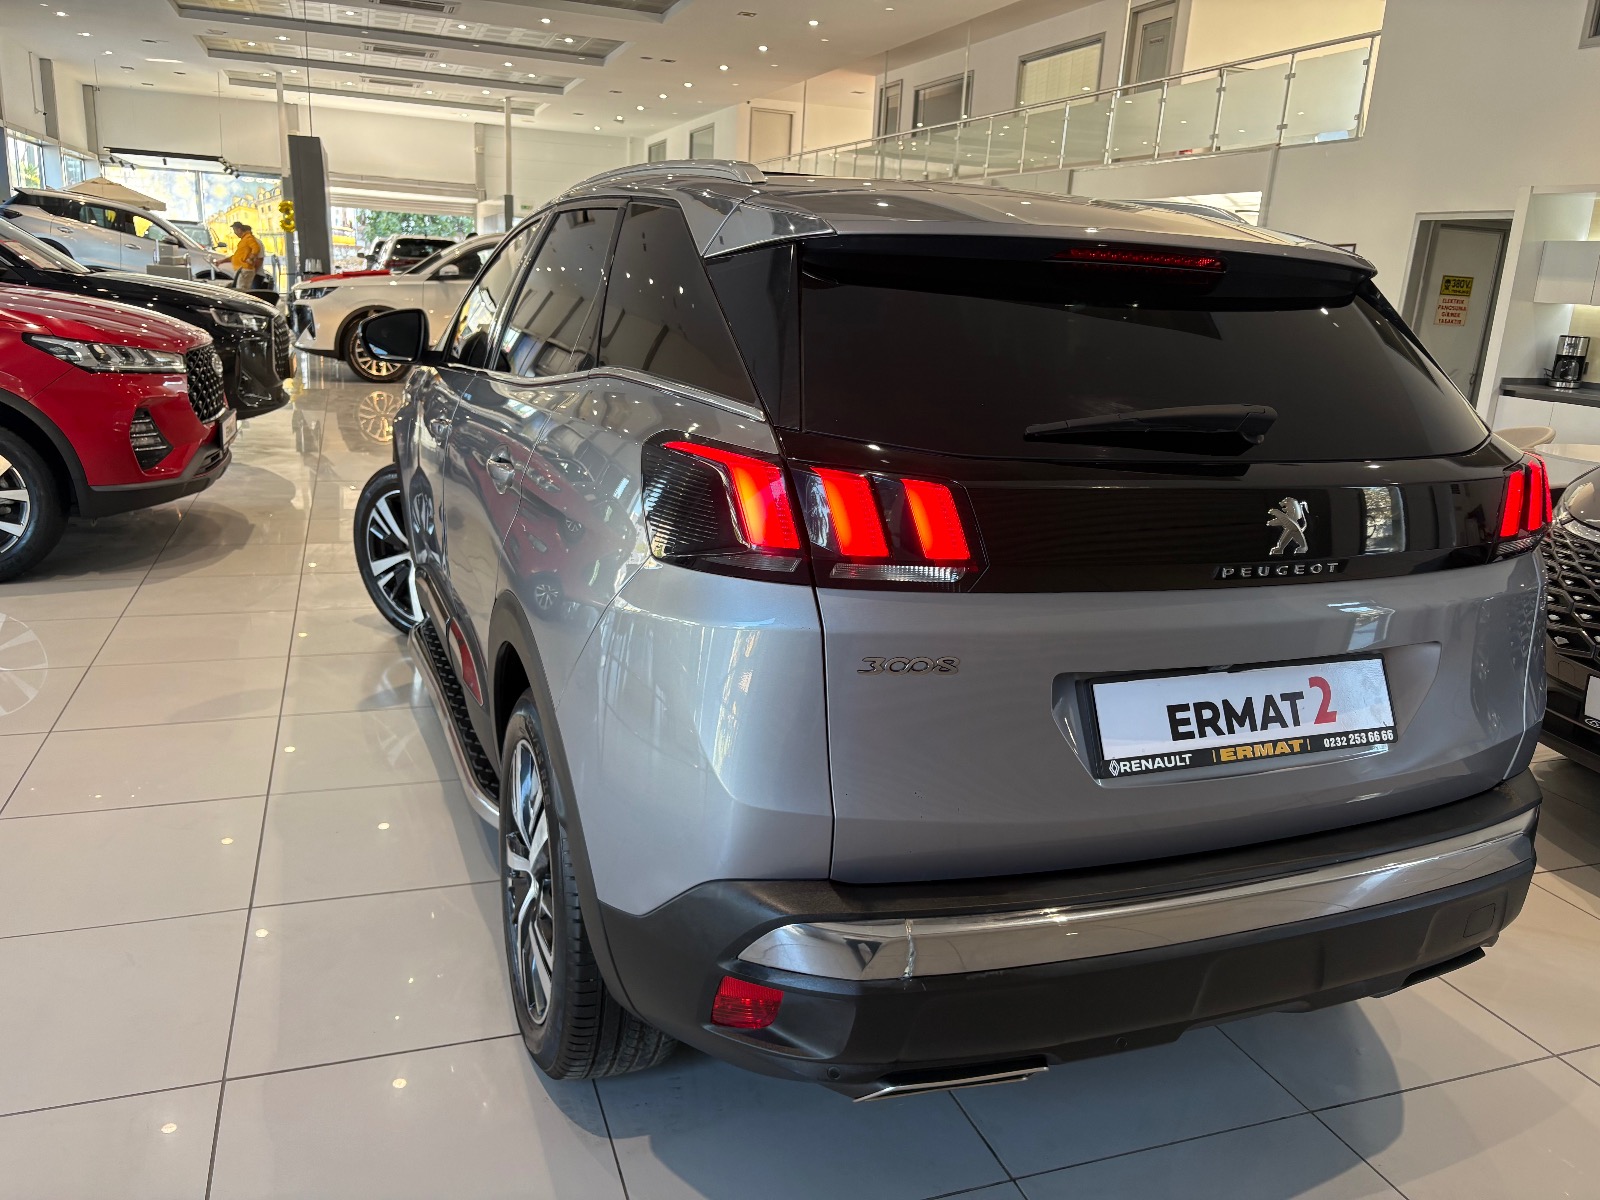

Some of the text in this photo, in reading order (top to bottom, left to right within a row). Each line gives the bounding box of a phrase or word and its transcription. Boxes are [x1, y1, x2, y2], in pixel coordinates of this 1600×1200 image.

[1221, 562, 1339, 579] PEUGEOT
[857, 656, 960, 676] 3008
[1166, 676, 1337, 742] ERMAT 2
[1119, 729, 1394, 773] RENAULT ERMAT 0232 253 66 66
